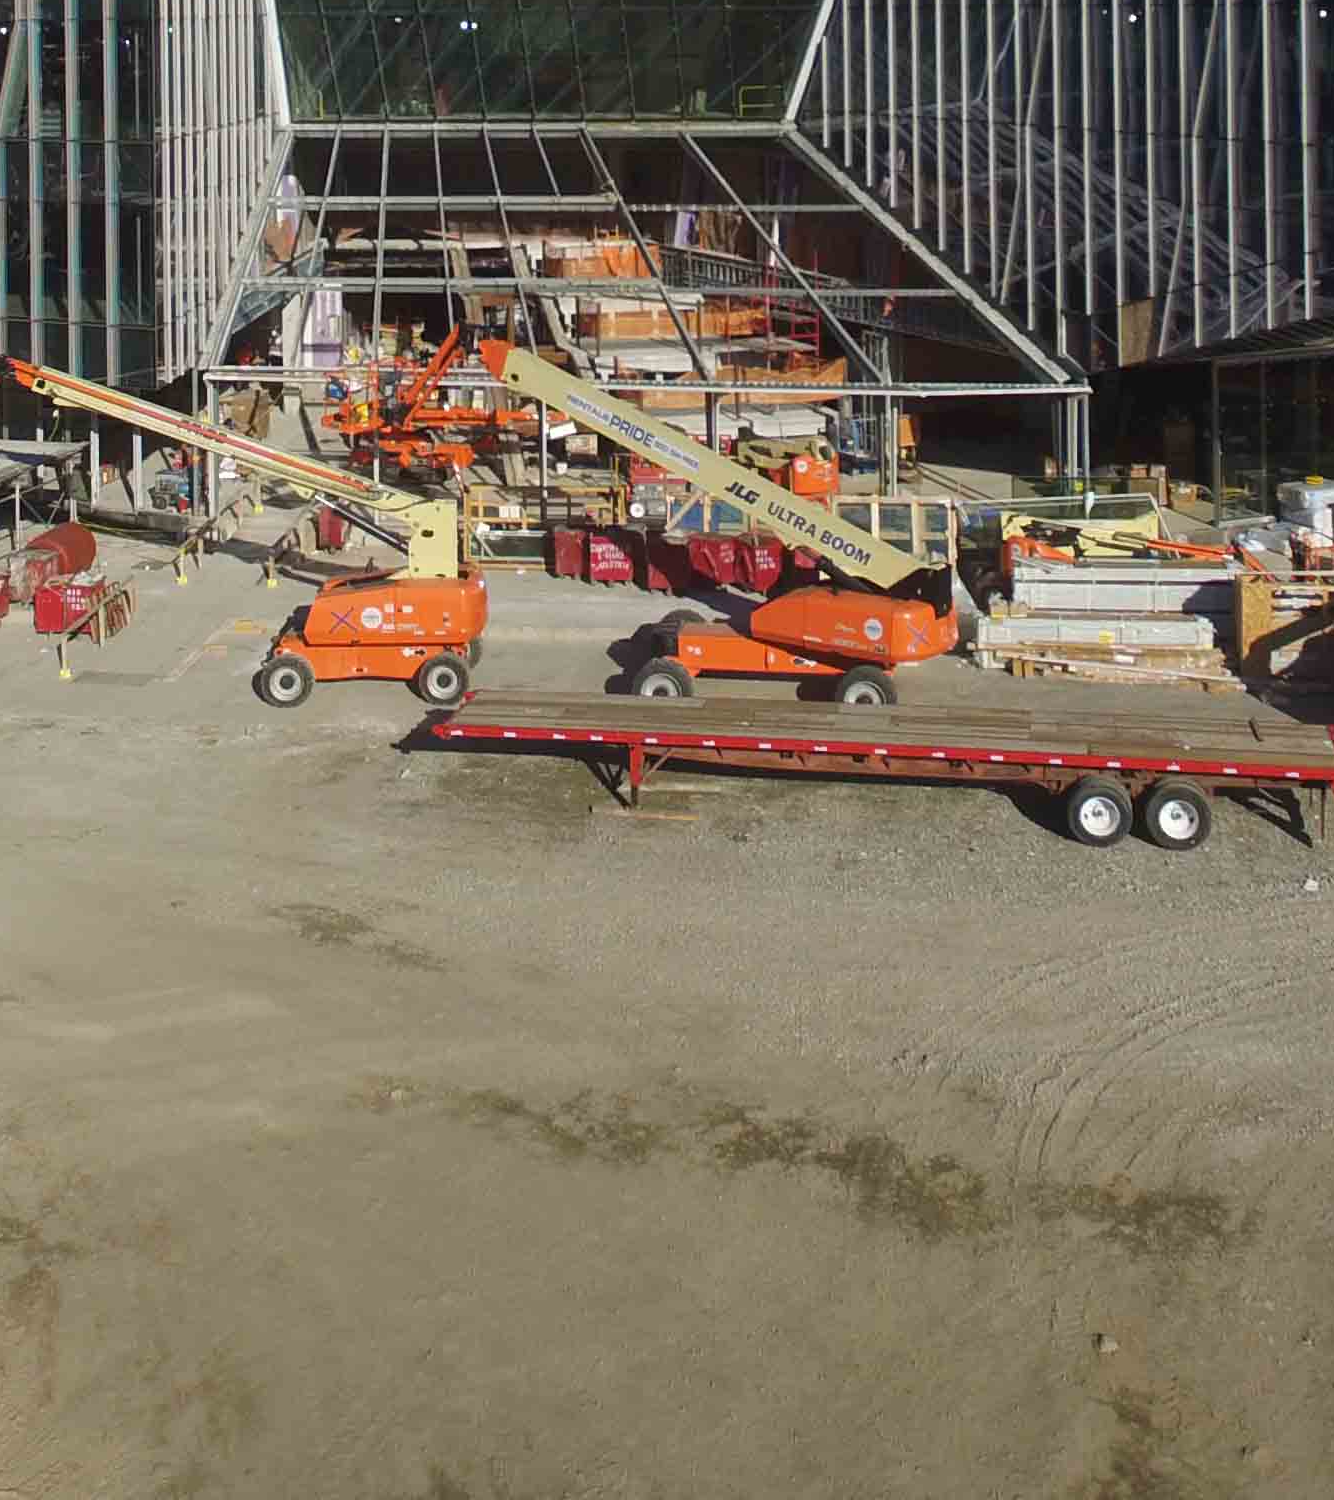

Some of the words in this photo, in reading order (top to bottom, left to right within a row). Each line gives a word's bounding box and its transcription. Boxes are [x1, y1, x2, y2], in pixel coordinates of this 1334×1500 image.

[609, 415, 655, 446] PRIDE
[724, 481, 760, 504] JLG
[767, 501, 816, 538] ULTRA
[819, 530, 872, 566] BOOM
